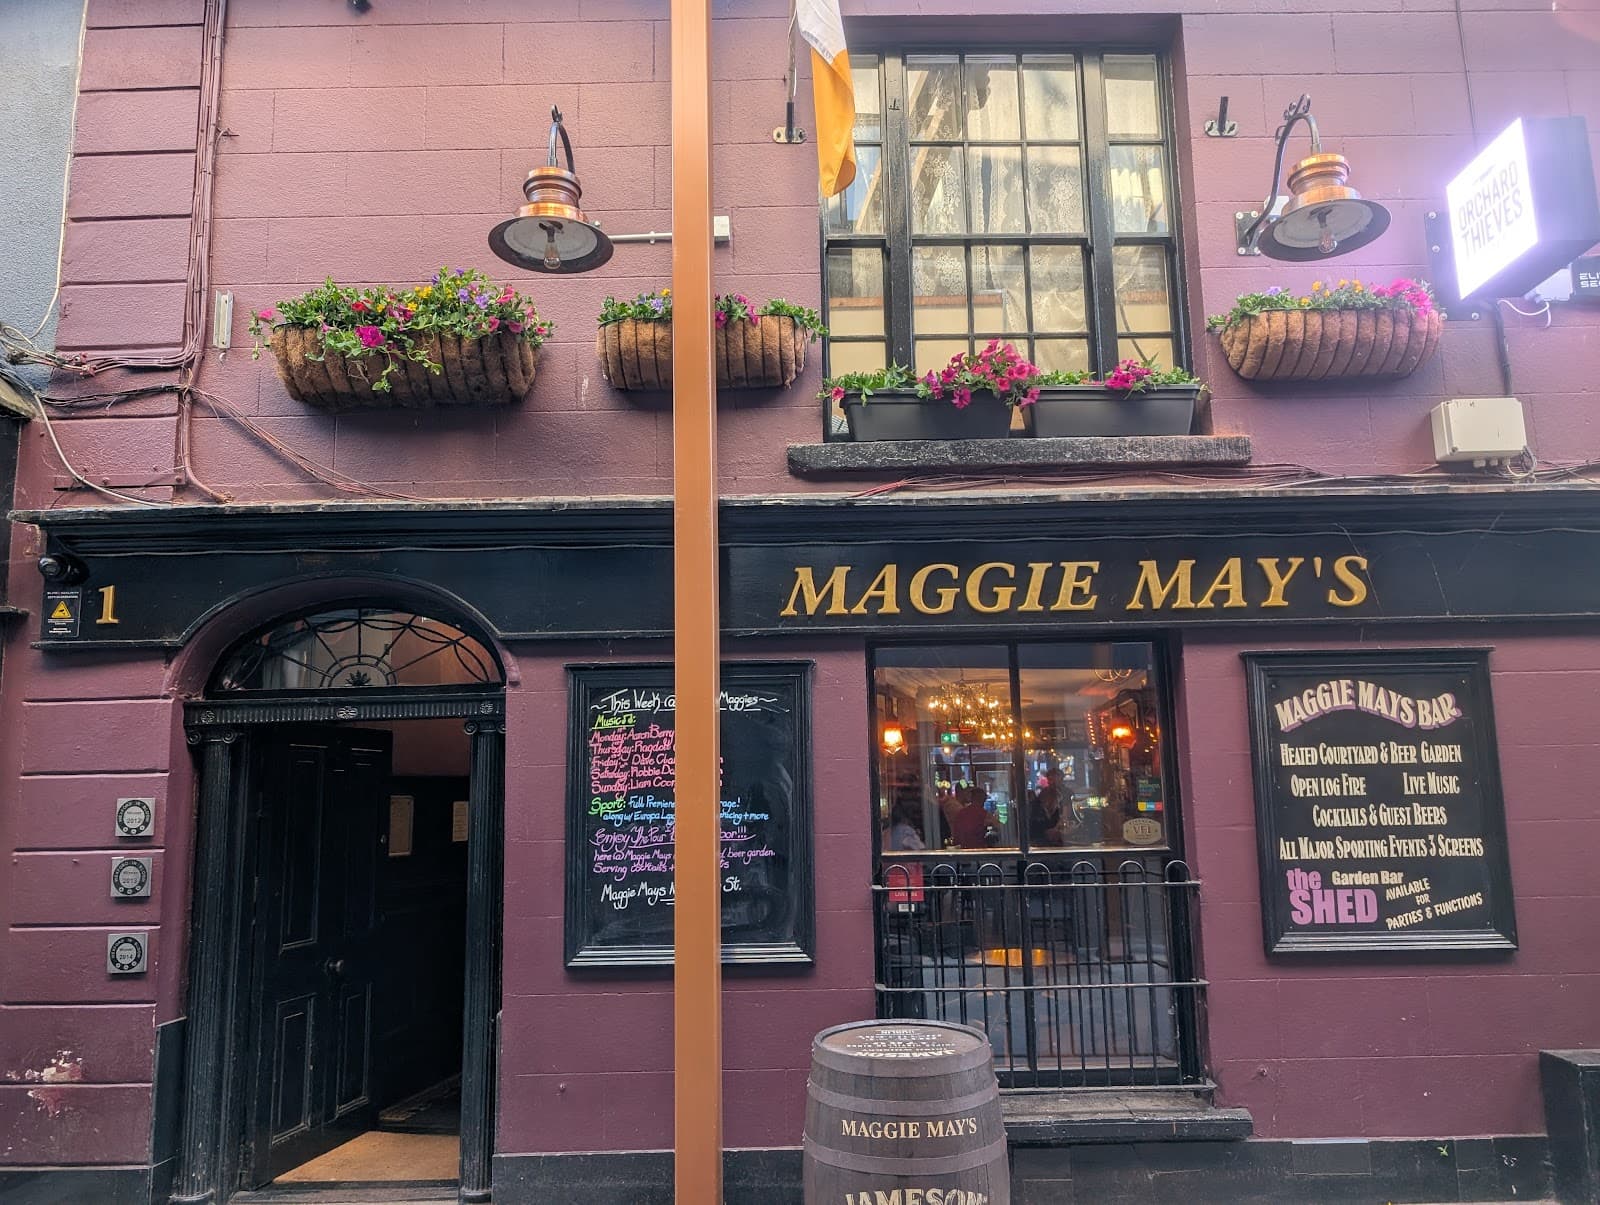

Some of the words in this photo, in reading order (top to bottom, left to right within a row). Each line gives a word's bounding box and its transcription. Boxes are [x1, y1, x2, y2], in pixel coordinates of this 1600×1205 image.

[1458, 160, 1518, 230] ORCHARD
[1462, 188, 1522, 257] THIEVES
[780, 560, 1101, 616] MAGGIE
[1126, 556, 1370, 610] MAY'S
[96, 584, 120, 624] 1
[601, 689, 630, 715] This
[634, 689, 660, 714] Week
[1274, 679, 1357, 733] MAGGIE
[1358, 680, 1416, 728] MAYS
[1416, 692, 1462, 730] BAR
[632, 754, 656, 765] Dave
[1280, 742, 1318, 766] HEATED
[1320, 742, 1378, 766] COURTYARD
[1380, 742, 1388, 764] &
[1390, 742, 1417, 765] BEER
[1420, 741, 1462, 764] GARDEN
[1290, 774, 1319, 797] OPEN
[1320, 776, 1340, 796] LOG
[1341, 773, 1366, 796] FIRE
[1403, 772, 1426, 795] LIVE
[1428, 772, 1460, 794] MUSIC
[590, 797, 626, 816] Sport:
[628, 796, 646, 808] Full
[633, 811, 660, 824] Europa
[1312, 804, 1368, 828] COCKTAILS
[1369, 806, 1378, 827] &
[1379, 804, 1412, 826] GUEST
[1414, 804, 1448, 826] BEERS
[593, 828, 631, 852] Enjoy
[1280, 838, 1298, 861] ALL
[1299, 836, 1335, 860] MAJOR
[1336, 836, 1388, 860] SPORTING
[1389, 835, 1428, 858] EVENTS
[1428, 834, 1436, 858] 3
[1438, 834, 1484, 858] SCREENS
[594, 849, 612, 862] here
[624, 850, 651, 867] Maggie
[652, 849, 672, 866] Mays
[728, 848, 744, 858] beer
[593, 863, 628, 882] Serving
[1286, 868, 1322, 890] the
[1332, 871, 1379, 886] Garden
[1381, 870, 1404, 884] Bar
[600, 884, 636, 910] Maggie
[637, 882, 666, 906] Mays
[723, 876, 742, 892] St.
[1386, 878, 1431, 901] AVAILABLE
[1416, 894, 1430, 906] FOR
[1288, 888, 1378, 926] SHED
[1386, 910, 1424, 931] PARTIES
[1426, 907, 1433, 920] &
[1434, 892, 1484, 918] FUNCTIONS
[841, 1119, 921, 1140] MAGGIE
[926, 1117, 978, 1138] MAY'S
